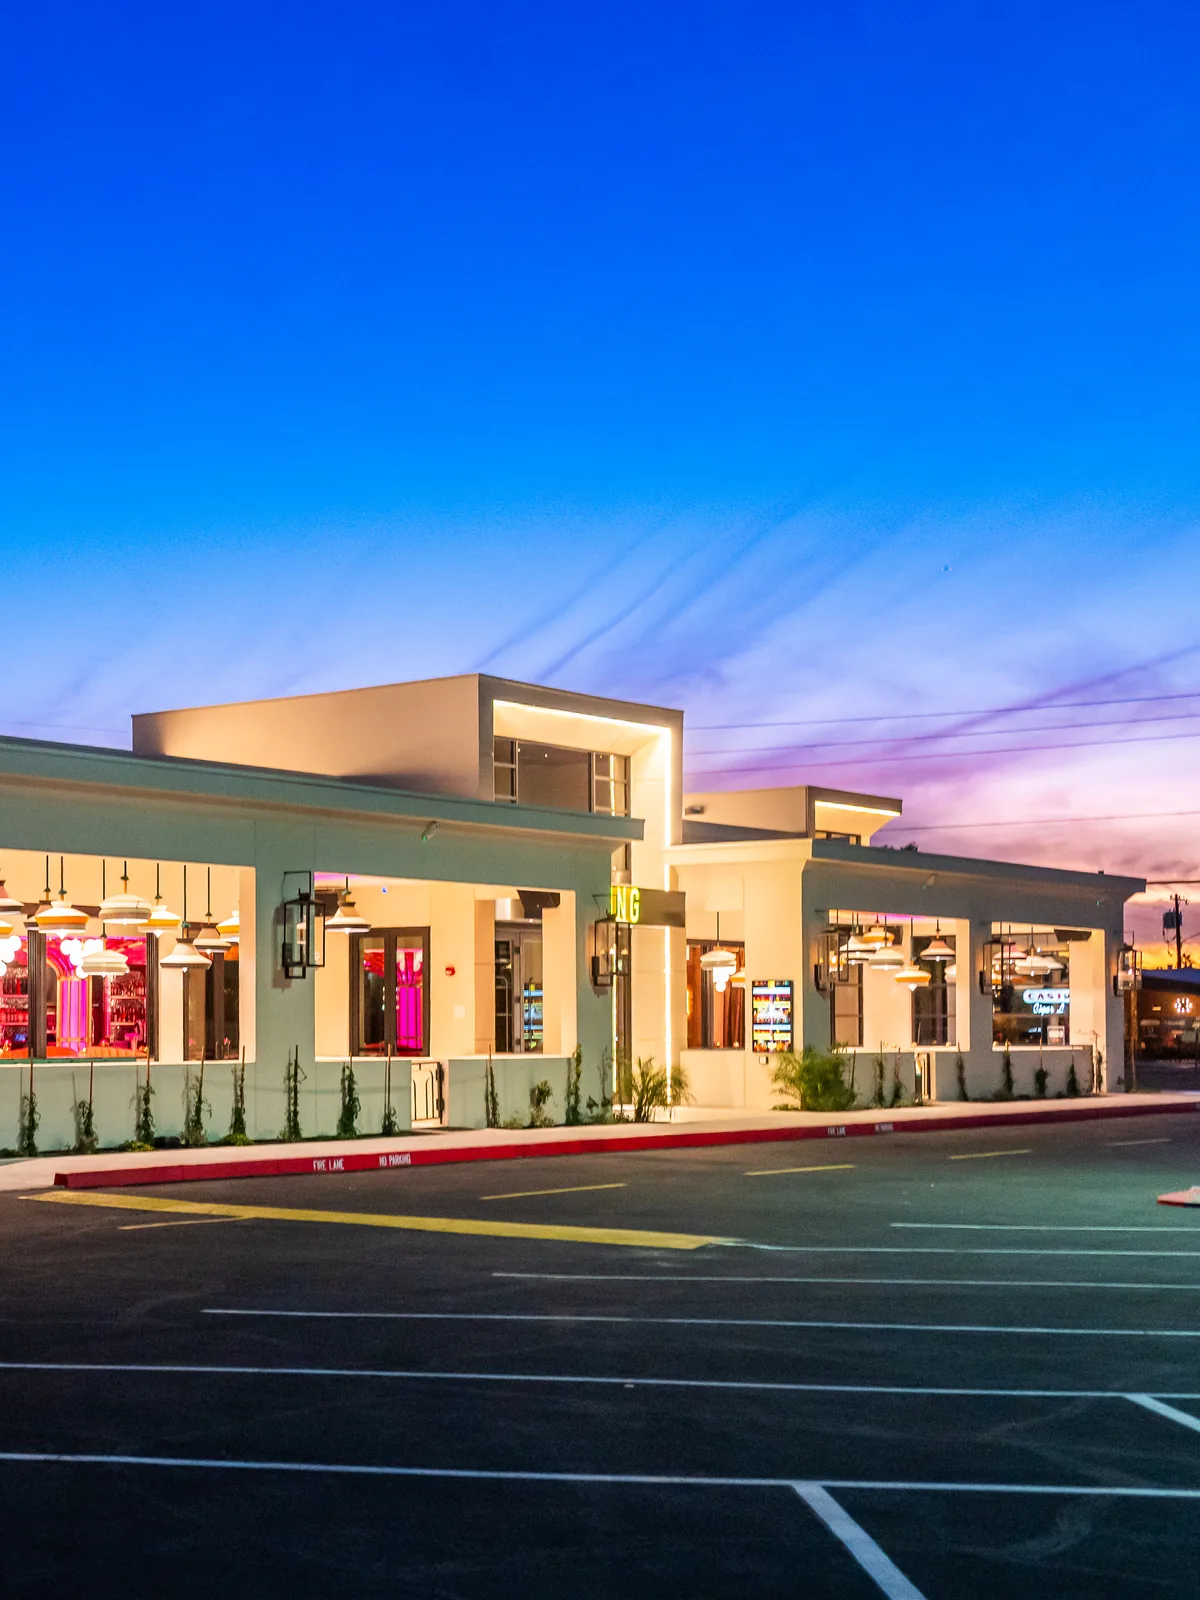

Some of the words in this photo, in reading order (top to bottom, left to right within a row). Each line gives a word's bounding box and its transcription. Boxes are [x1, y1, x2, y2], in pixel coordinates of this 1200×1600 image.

[313, 1159, 327, 1171] FIRE
[328, 1158, 344, 1171] LANE
[378, 1155, 387, 1166] NO
[388, 1153, 411, 1165] PARKING
